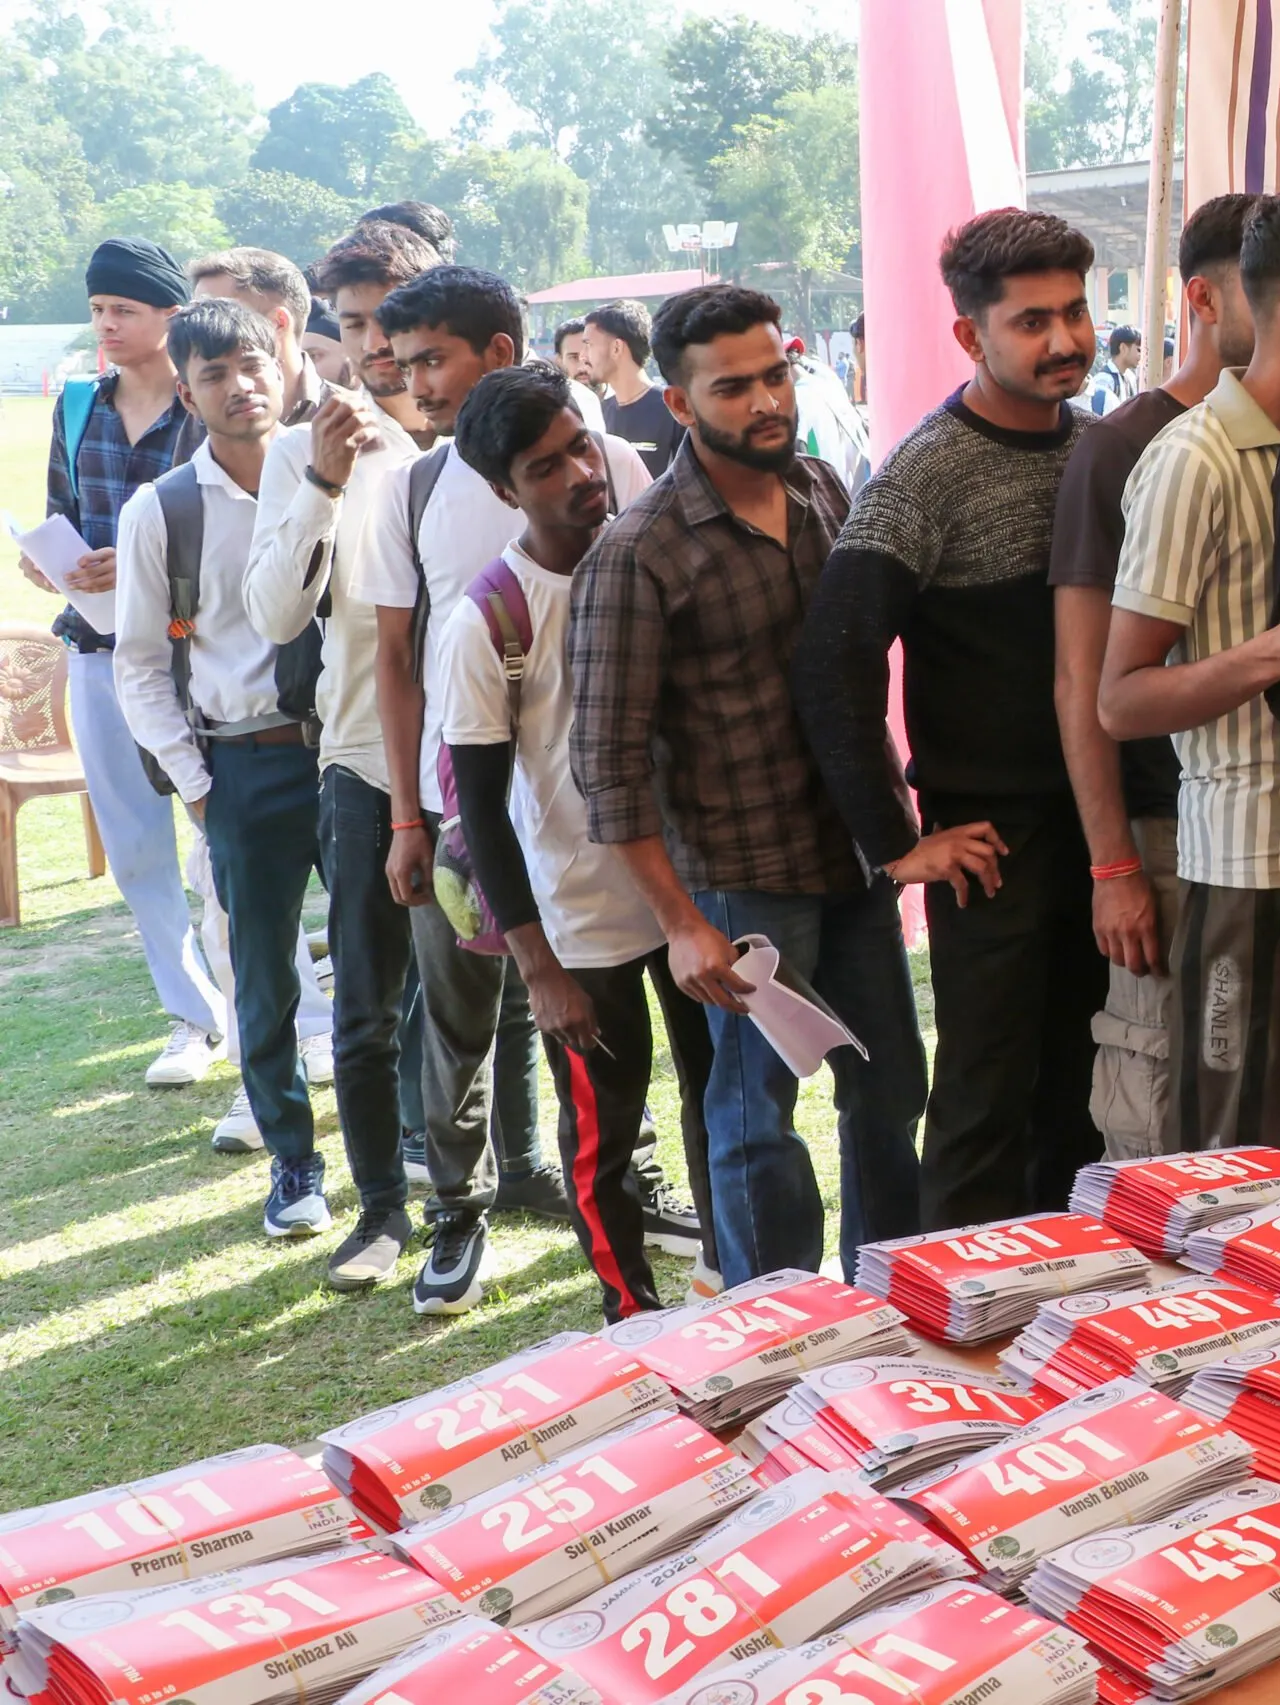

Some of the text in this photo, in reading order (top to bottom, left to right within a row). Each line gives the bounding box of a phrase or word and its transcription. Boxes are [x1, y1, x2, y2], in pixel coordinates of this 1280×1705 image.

[1211, 961, 1230, 1064] SHANLEY
[1164, 1153, 1273, 1181] 581
[944, 1224, 1063, 1264] 461
[1018, 1262, 1046, 1277] Sunil
[681, 1296, 813, 1352] 341
[1128, 1291, 1253, 1330] 491
[806, 1326, 841, 1347] Singh
[1172, 1335, 1233, 1360] Mohammad
[1232, 1323, 1273, 1345] Rezwan
[414, 1372, 563, 1451] 221
[889, 1380, 1026, 1422] 371
[500, 1414, 578, 1463] Ajaz Ahmed
[977, 1425, 1126, 1497] 401
[710, 1472, 742, 1491] INDIA
[714, 1487, 748, 1506] INDIA
[1059, 1469, 1150, 1519] Vansh Babulia
[62, 1478, 235, 1551] 101
[302, 1502, 338, 1524] FIT
[481, 1454, 639, 1553] 251
[308, 1514, 344, 1531] INDIA
[564, 1530, 607, 1561] Suaj
[605, 1504, 653, 1537] Kumar
[130, 1550, 188, 1578] Prerna
[190, 1529, 254, 1559] Sharma
[650, 1553, 698, 1588] 2025
[850, 1557, 884, 1586] FIT
[600, 1577, 643, 1612] JAMMU
[858, 1568, 892, 1593] INDIA
[158, 1578, 341, 1651] 131
[413, 1597, 449, 1619] FIT
[422, 1609, 458, 1626] INDIA
[620, 1551, 782, 1682] 281
[1156, 1597, 1181, 1616] FULL
[264, 1630, 360, 1680] Shahbaz Ali
[730, 1630, 774, 1663] Visha
[745, 1632, 847, 1680] JAMMU 2025
[1045, 1642, 1075, 1665] INDIA
[785, 1633, 959, 1705] 311
[1053, 1662, 1087, 1687] INDIA
[948, 1675, 1003, 1705] harma
